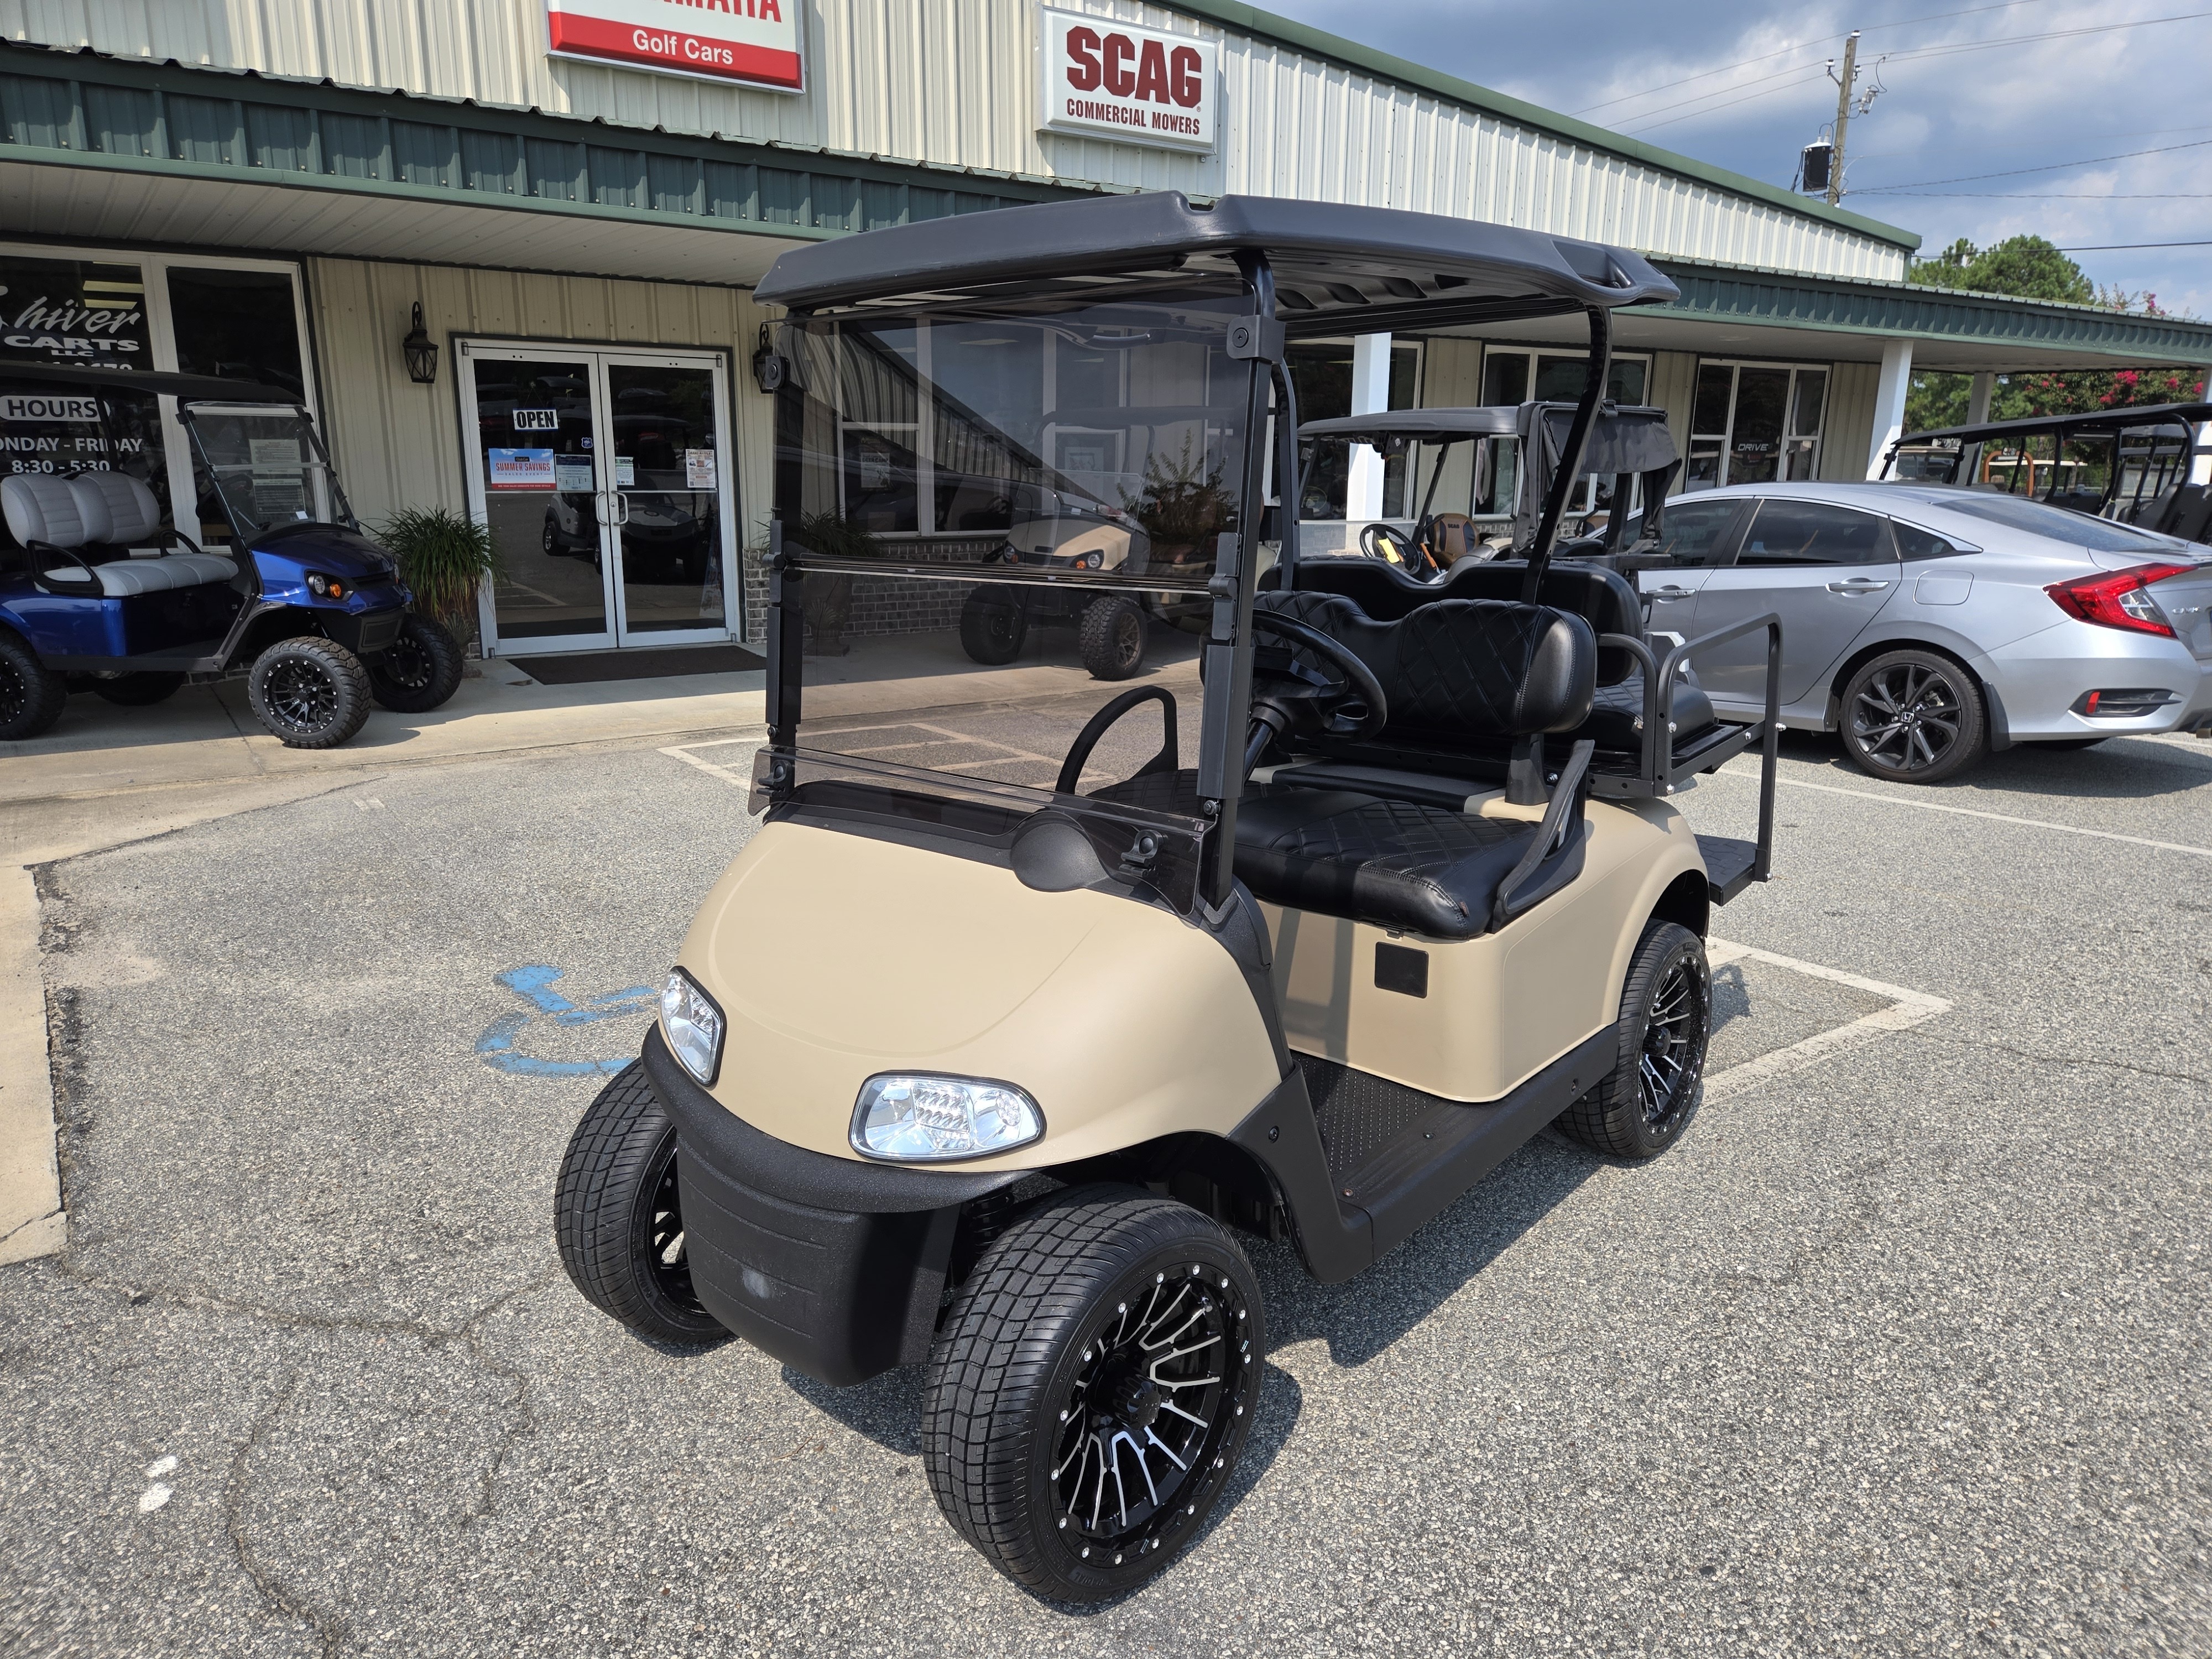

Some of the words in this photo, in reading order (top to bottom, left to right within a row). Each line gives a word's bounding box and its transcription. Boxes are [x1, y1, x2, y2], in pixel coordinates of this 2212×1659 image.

[633, 29, 677, 56] Golf
[685, 38, 733, 65] Cars
[1067, 25, 1202, 108] SCAG
[1067, 98, 1146, 127] COMMERCIAL
[1151, 112, 1200, 135] MOWERS
[0, 285, 140, 333] hiver
[4, 335, 140, 351] CARTS
[7, 399, 98, 418] HOURS
[516, 411, 555, 429] OPEN
[12, 460, 54, 473] 8:30
[70, 460, 110, 472] 5:30
[495, 462, 523, 471] SUMMER
[525, 463, 550, 471] SAVINGS
